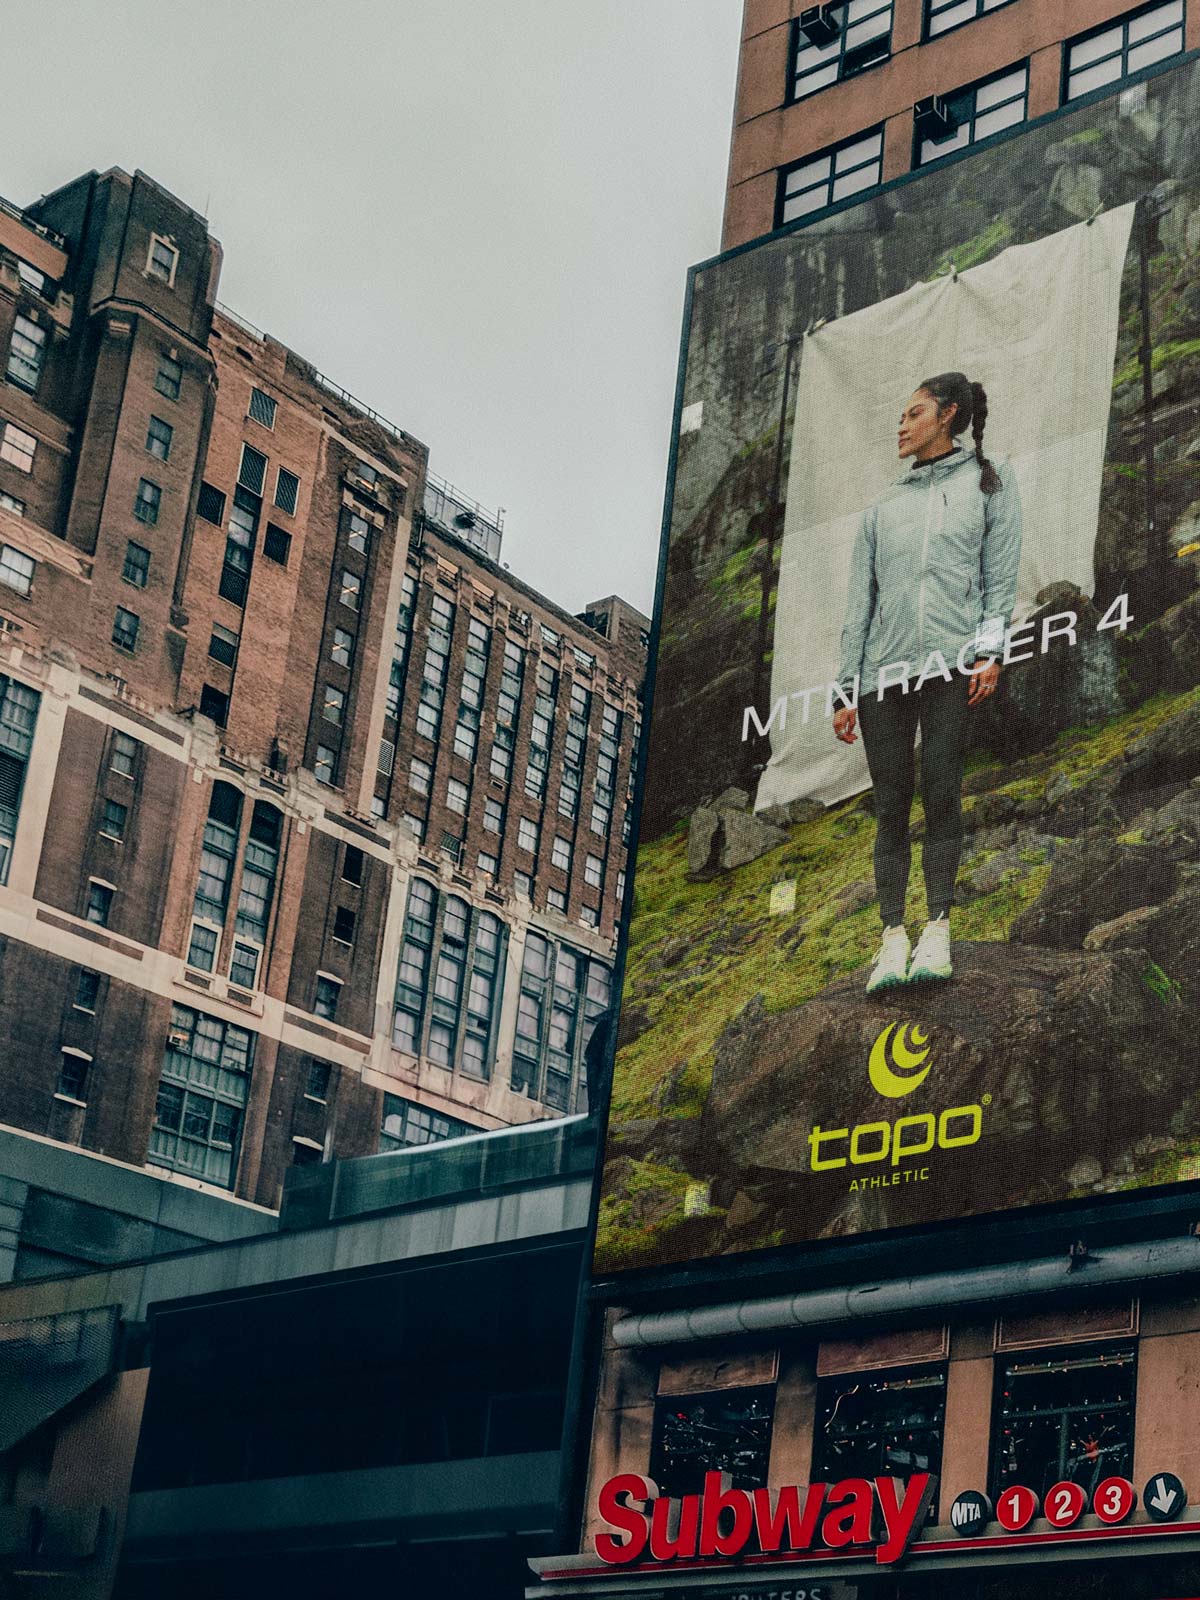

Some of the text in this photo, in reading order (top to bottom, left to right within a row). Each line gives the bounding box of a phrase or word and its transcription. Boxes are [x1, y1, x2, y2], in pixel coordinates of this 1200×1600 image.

[742, 594, 1134, 741] MTN RACER 4
[808, 1105, 982, 1171] topo
[849, 1168, 929, 1192] ATHLETIC
[595, 1470, 1122, 1564] Subway MTA 1 2 3
